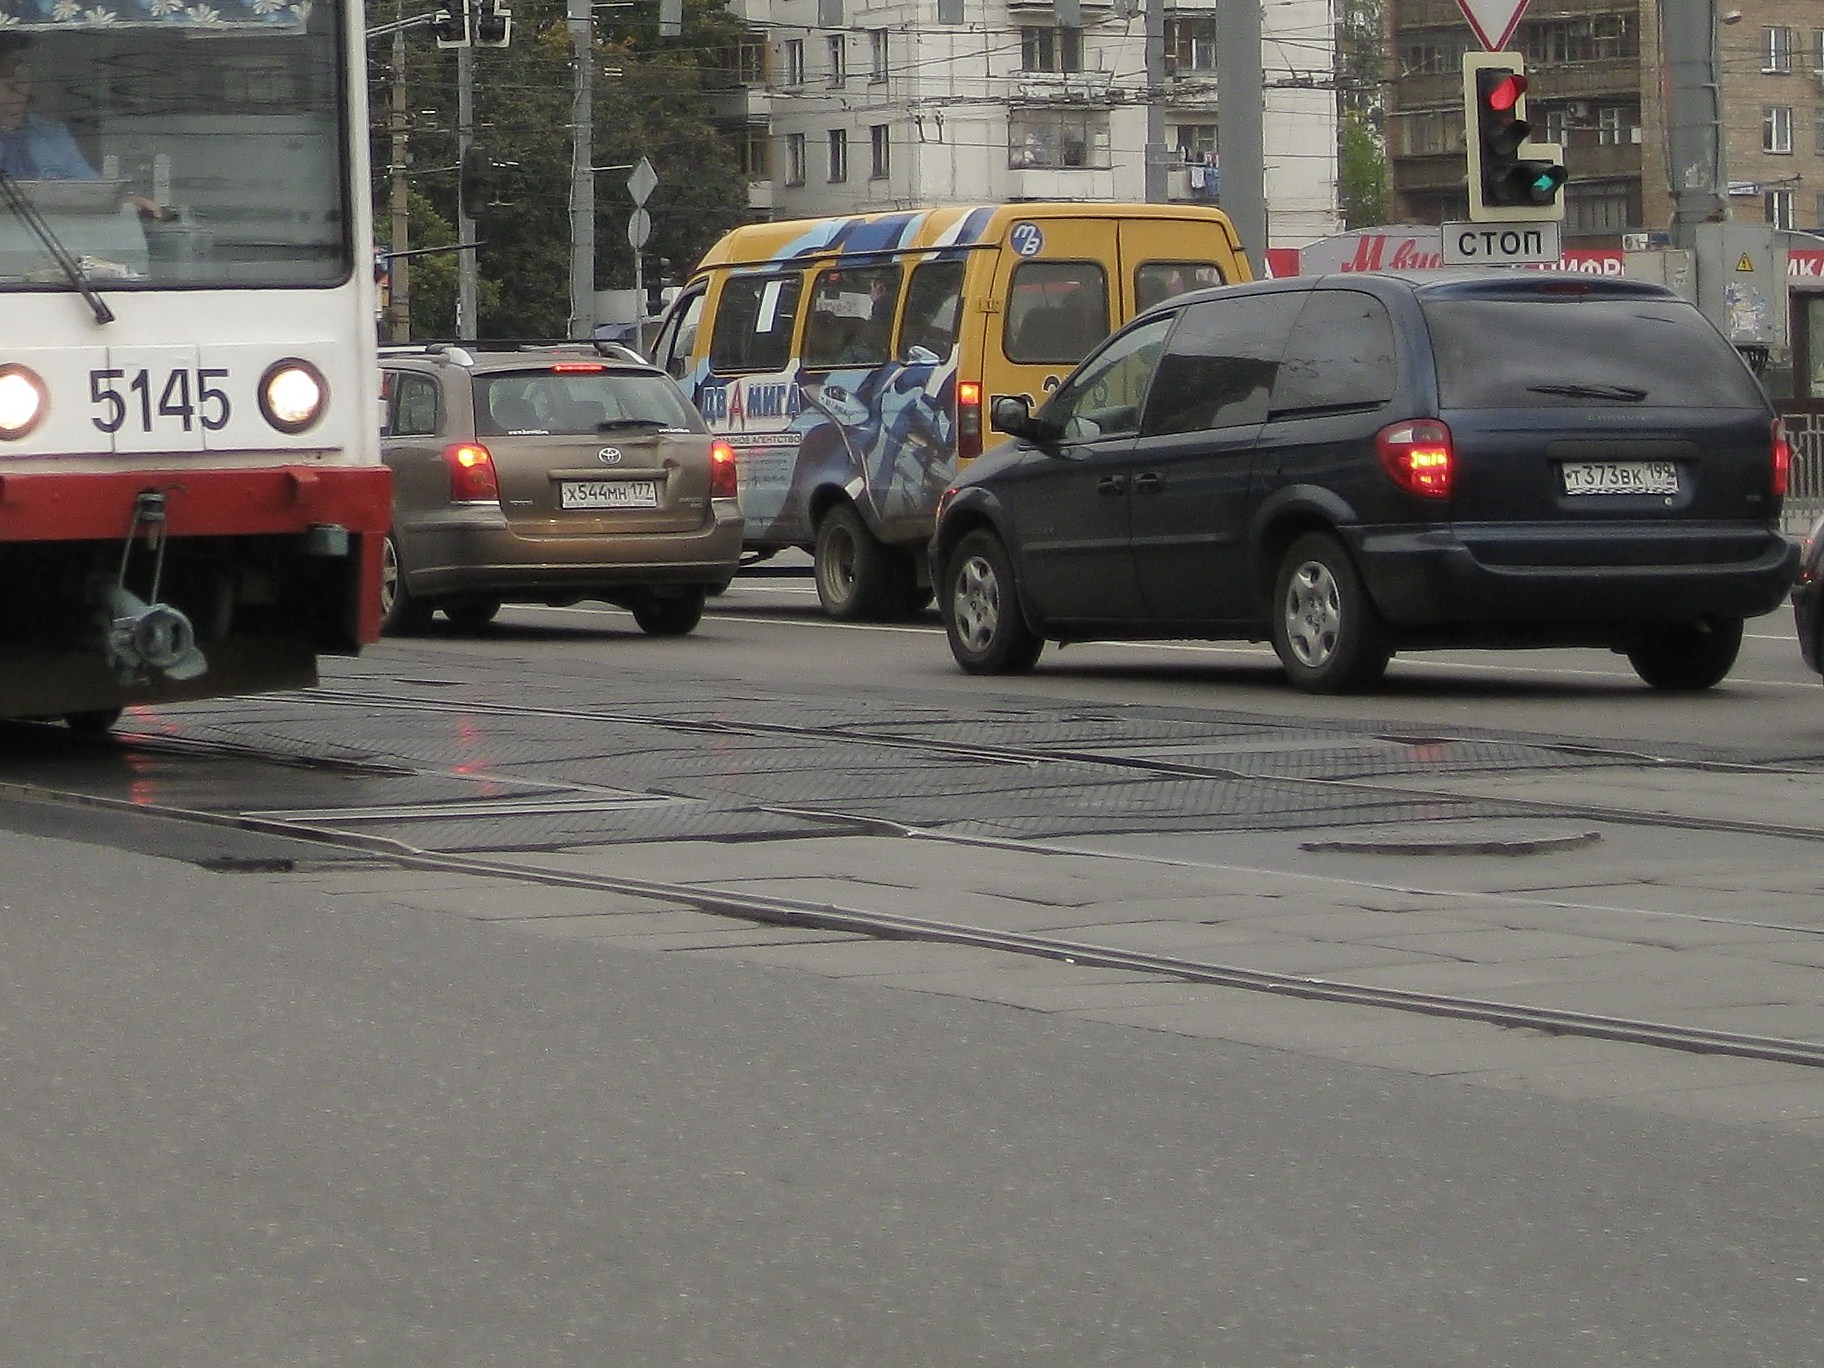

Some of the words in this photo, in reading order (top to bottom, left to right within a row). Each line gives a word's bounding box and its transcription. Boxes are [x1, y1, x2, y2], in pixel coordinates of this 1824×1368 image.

[1458, 230, 1543, 257] СТОП
[89, 369, 231, 434] 5145
[746, 383, 802, 419] МИГА
[751, 435, 801, 445] АГЕНТСТВО
